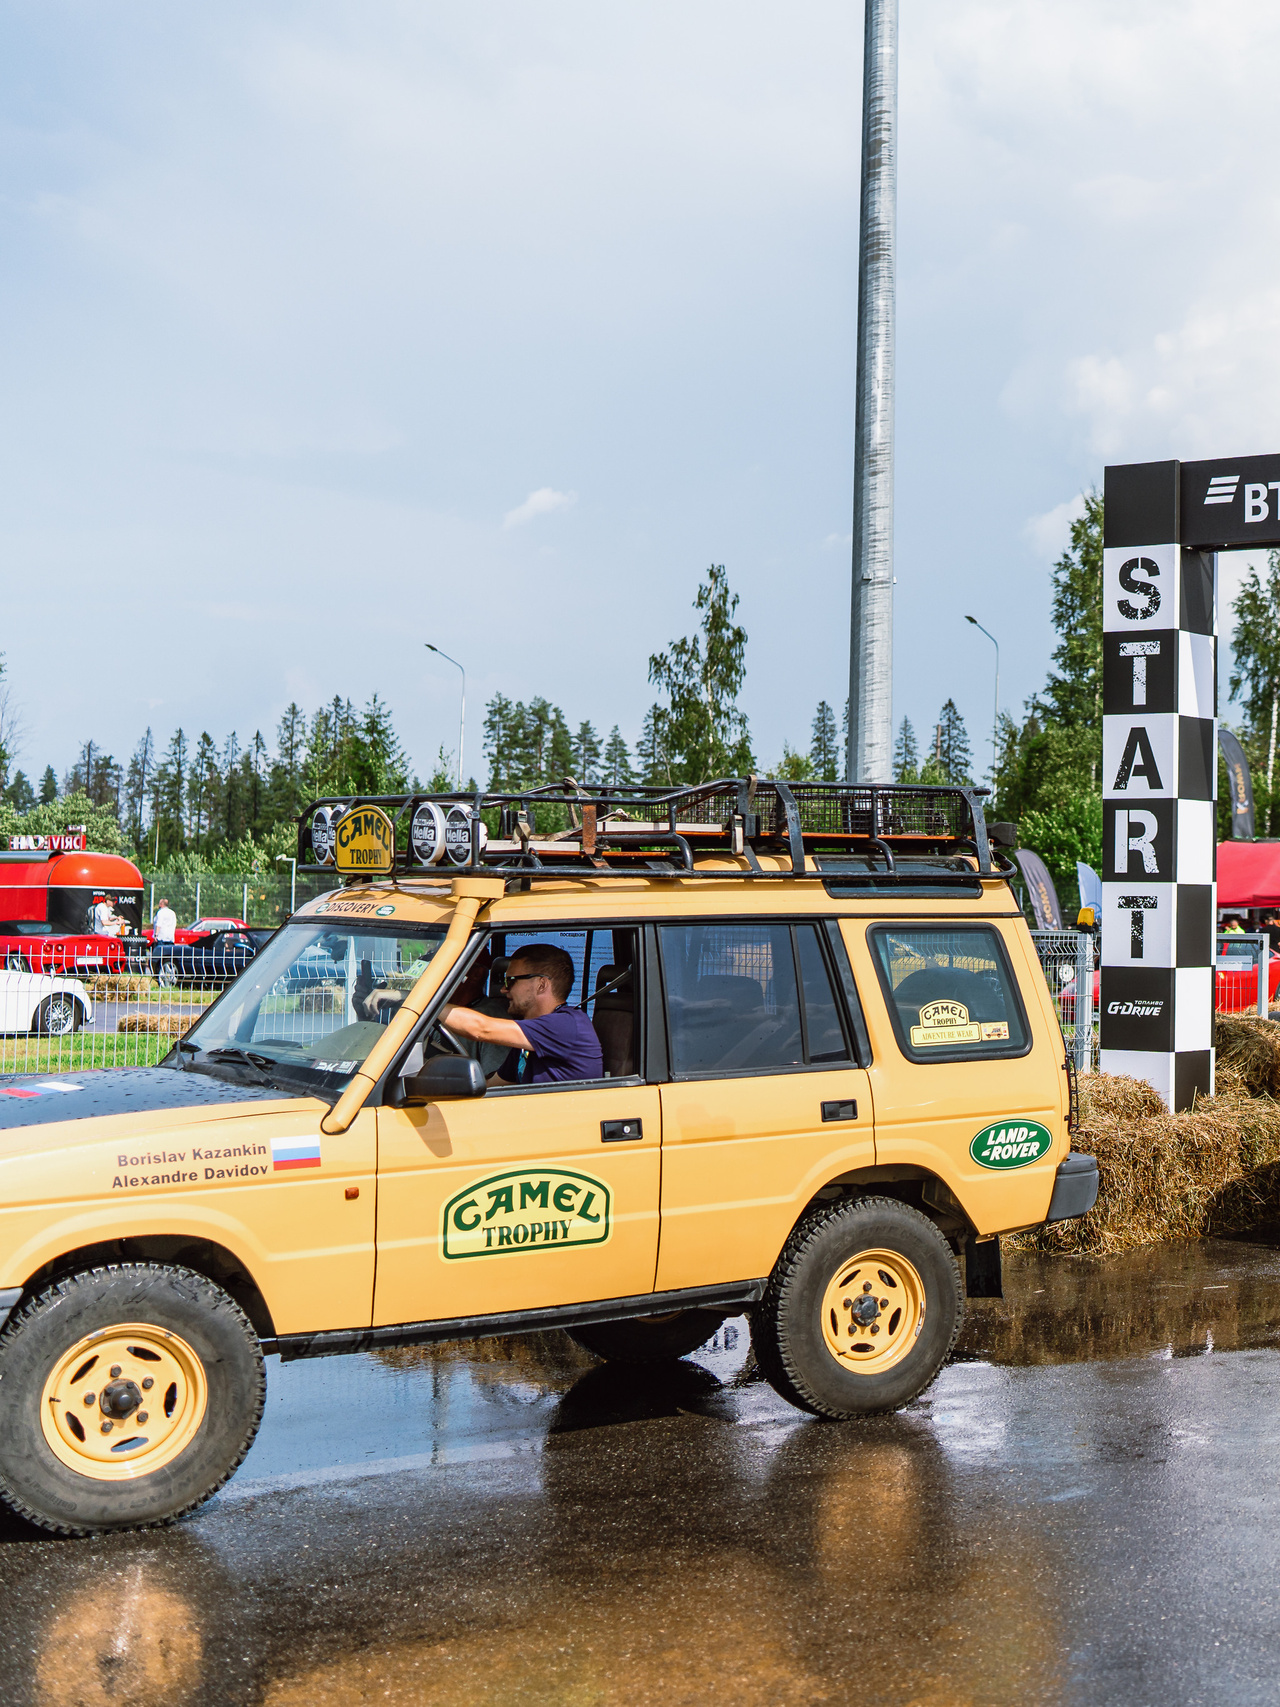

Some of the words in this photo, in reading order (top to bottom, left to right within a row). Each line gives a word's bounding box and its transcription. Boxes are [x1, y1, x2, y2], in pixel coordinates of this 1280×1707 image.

[1112, 556, 1164, 960] START
[338, 814, 389, 851] CAMEL
[413, 825, 434, 840] Hella
[446, 829, 469, 842] Hella
[350, 848, 382, 865] TROPHY
[326, 902, 378, 914] DISCOVERY
[924, 1005, 965, 1020] CAMEL
[933, 1018, 957, 1026] TROPHY
[922, 1031, 955, 1040] ADVENTURE
[956, 1029, 973, 1038] WEAR
[987, 1127, 1029, 1146] LAND
[117, 1150, 187, 1168] Borislav
[192, 1143, 267, 1161] Kazankin
[989, 1141, 1040, 1161] ROVER
[112, 1169, 198, 1189] Alexandre
[204, 1164, 269, 1180] Davidov
[453, 1181, 601, 1231] CAMEL
[482, 1219, 573, 1248] TROPHY
